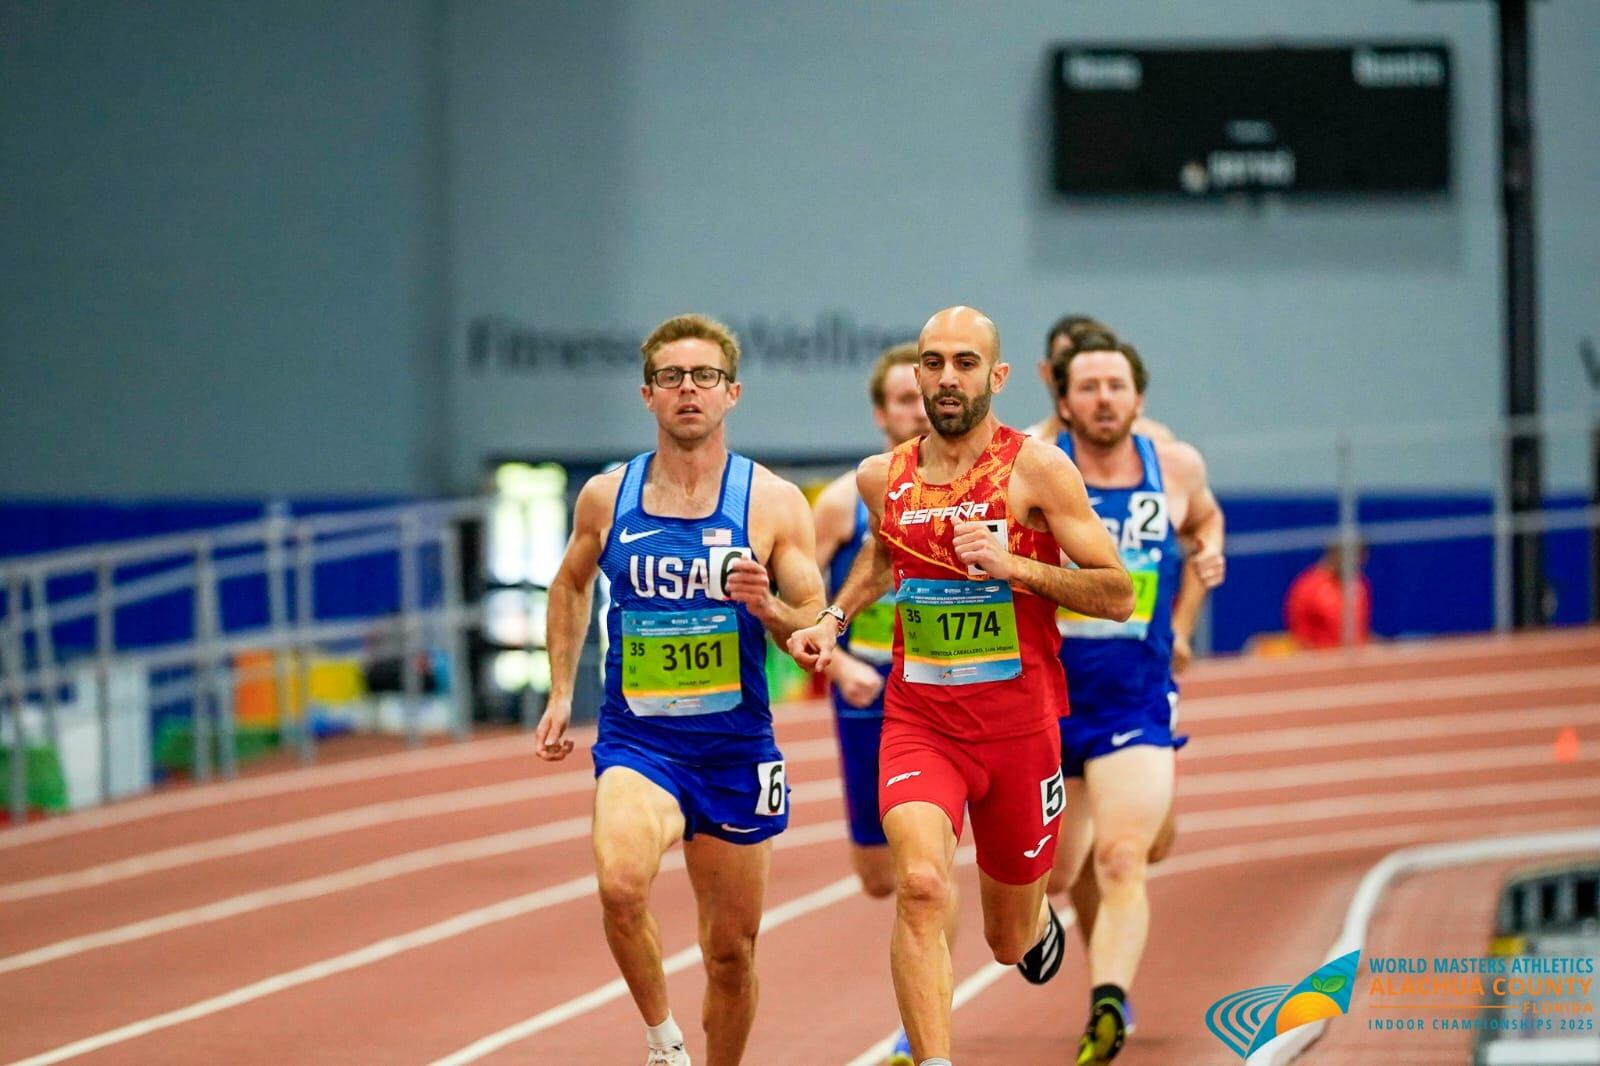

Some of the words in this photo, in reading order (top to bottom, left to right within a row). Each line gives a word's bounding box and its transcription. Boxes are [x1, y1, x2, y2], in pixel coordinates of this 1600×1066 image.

[899, 502, 989, 525] ESPAÑA
[1139, 499, 1160, 535] 2
[629, 554, 710, 600] USA
[906, 608, 922, 624] 35
[936, 610, 1001, 641] 1774
[630, 642, 645, 657] 35
[661, 640, 723, 672] 3161
[767, 764, 783, 813] 6
[1045, 774, 1063, 818] 5
